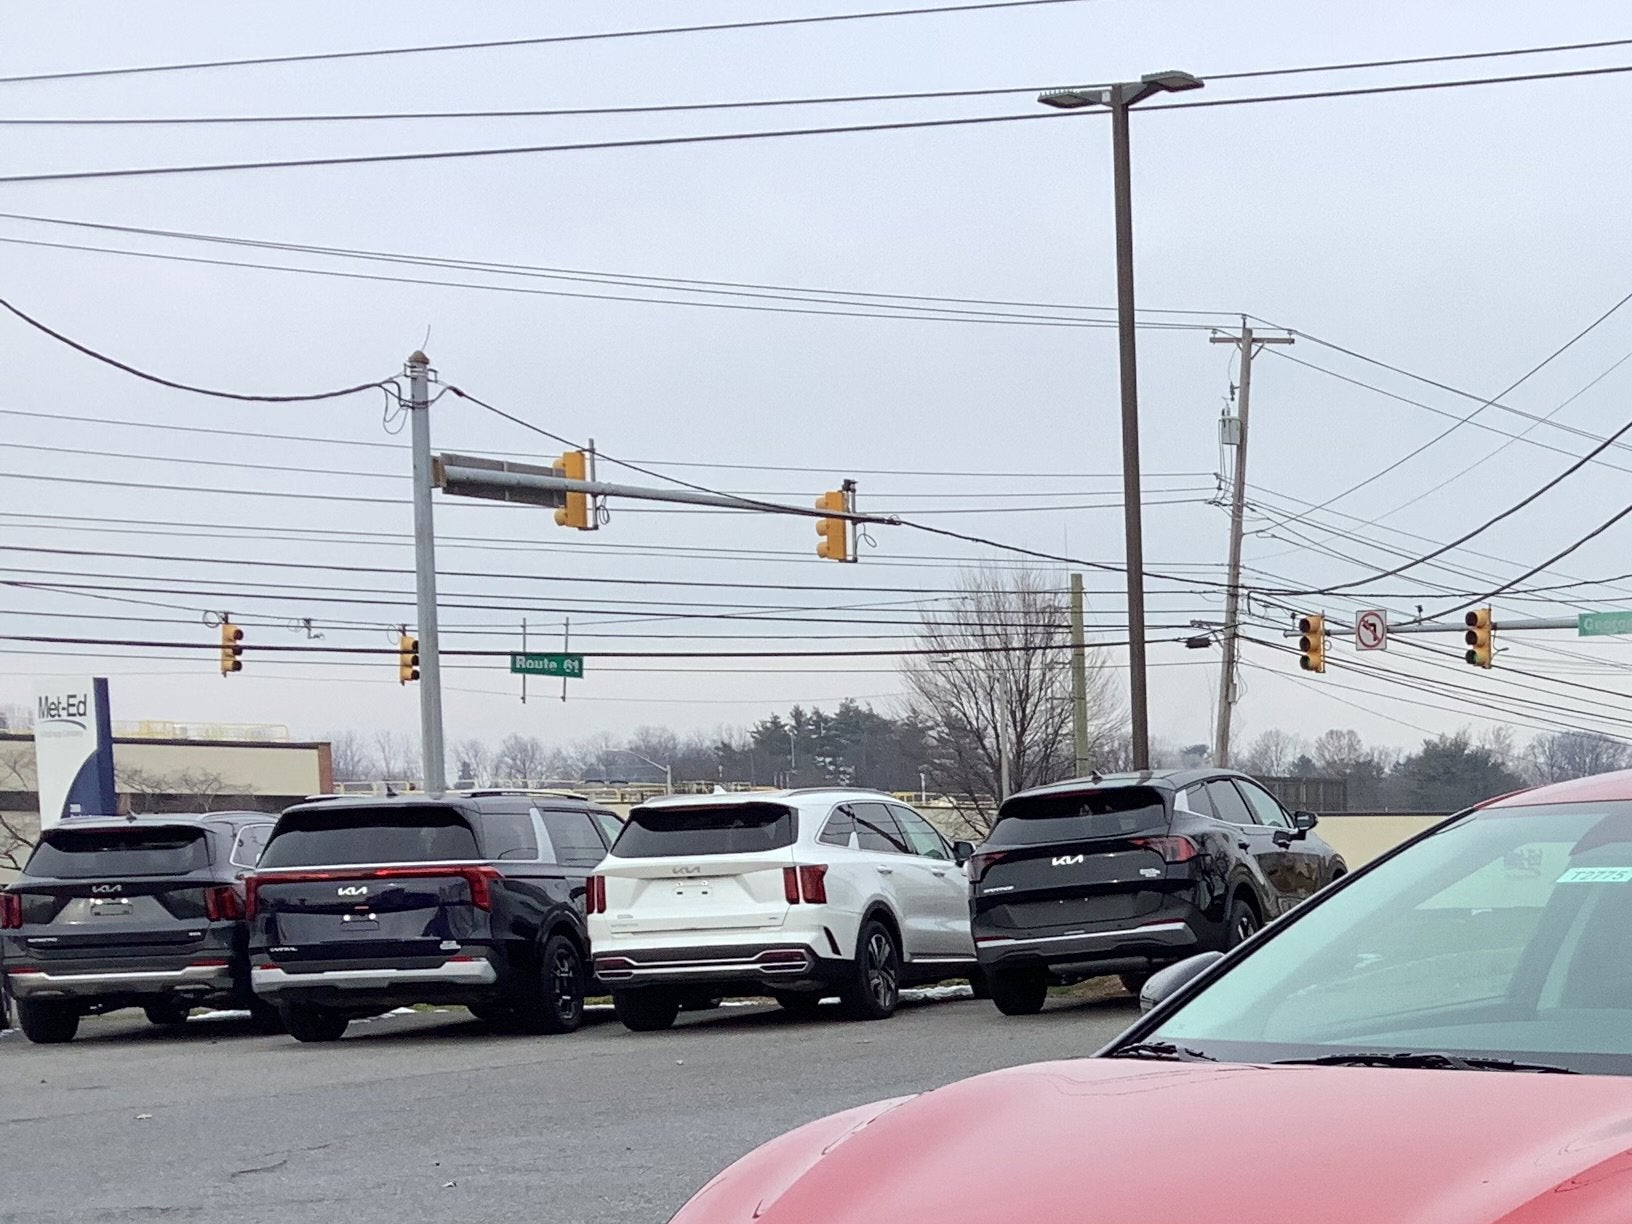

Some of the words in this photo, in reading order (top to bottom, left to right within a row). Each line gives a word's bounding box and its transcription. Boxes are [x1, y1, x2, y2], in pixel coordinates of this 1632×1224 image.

[515, 656, 558, 671] Route
[563, 659, 580, 673] 61
[38, 693, 87, 719] Met-Ed
[1051, 854, 1084, 866] KIA
[671, 866, 701, 874] KIA
[91, 884, 122, 893] KIA
[337, 886, 368, 897] KIA
